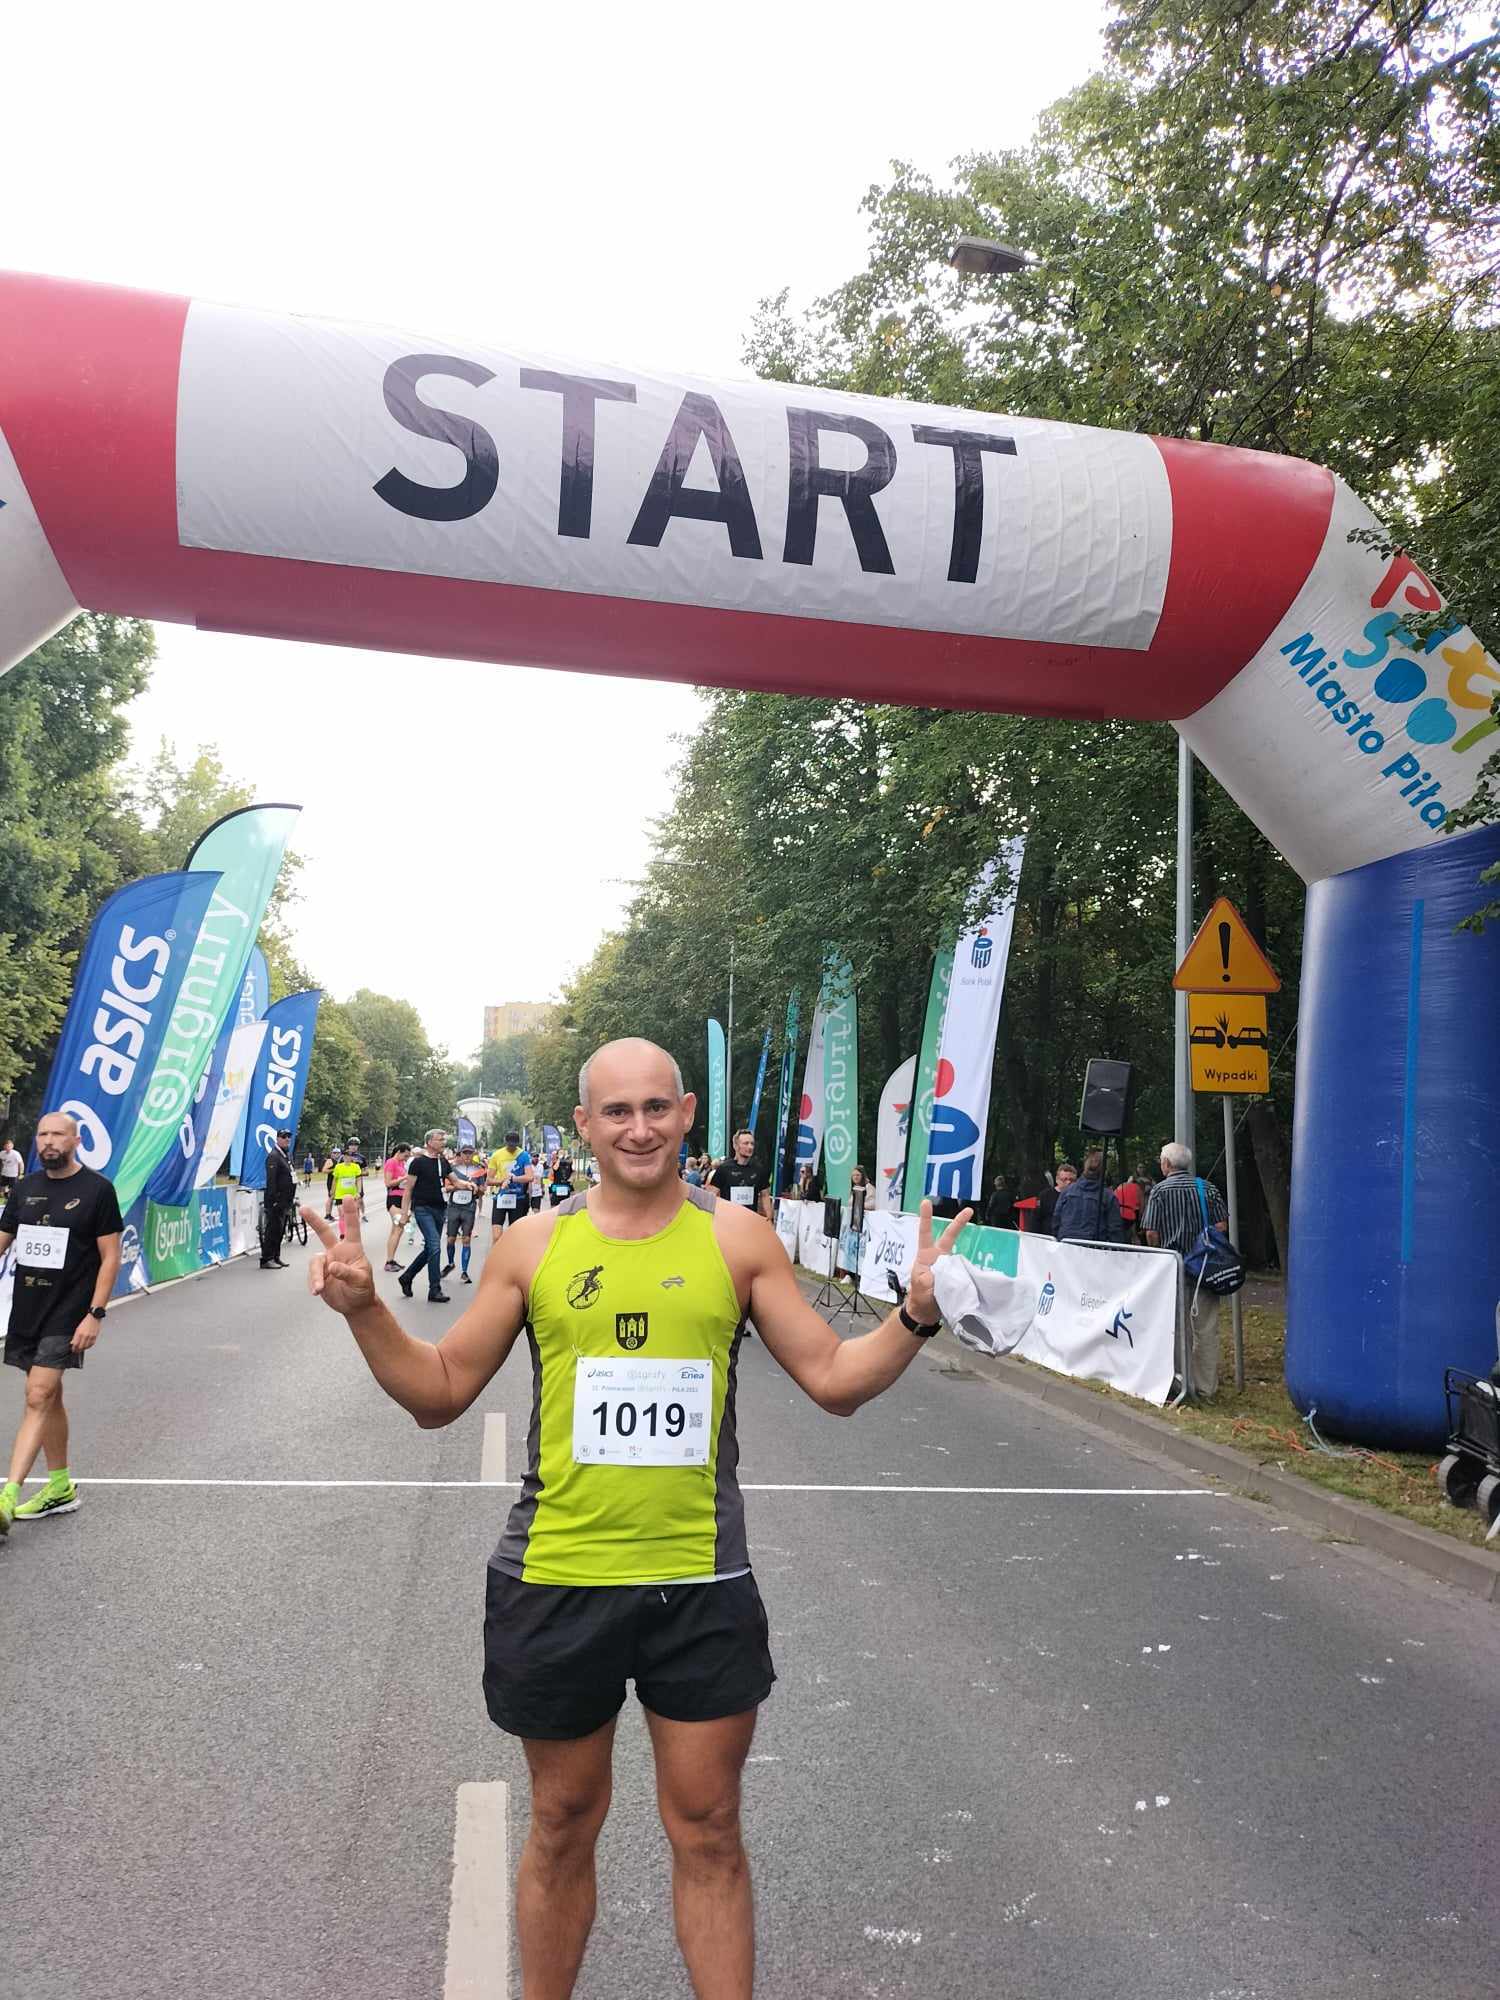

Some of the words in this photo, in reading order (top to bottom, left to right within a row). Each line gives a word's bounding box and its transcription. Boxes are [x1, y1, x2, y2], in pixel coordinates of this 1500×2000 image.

[372, 353, 1017, 583] START
[1279, 632, 1385, 754] Miasto
[1381, 751, 1450, 829] Piła
[80, 924, 171, 1096] asics
[263, 1025, 302, 1120] asics
[1204, 1068, 1257, 1083] Wypadki
[25, 1241, 51, 1256] 859
[680, 1370, 705, 1380] Enea
[592, 1401, 686, 1437] 1019
